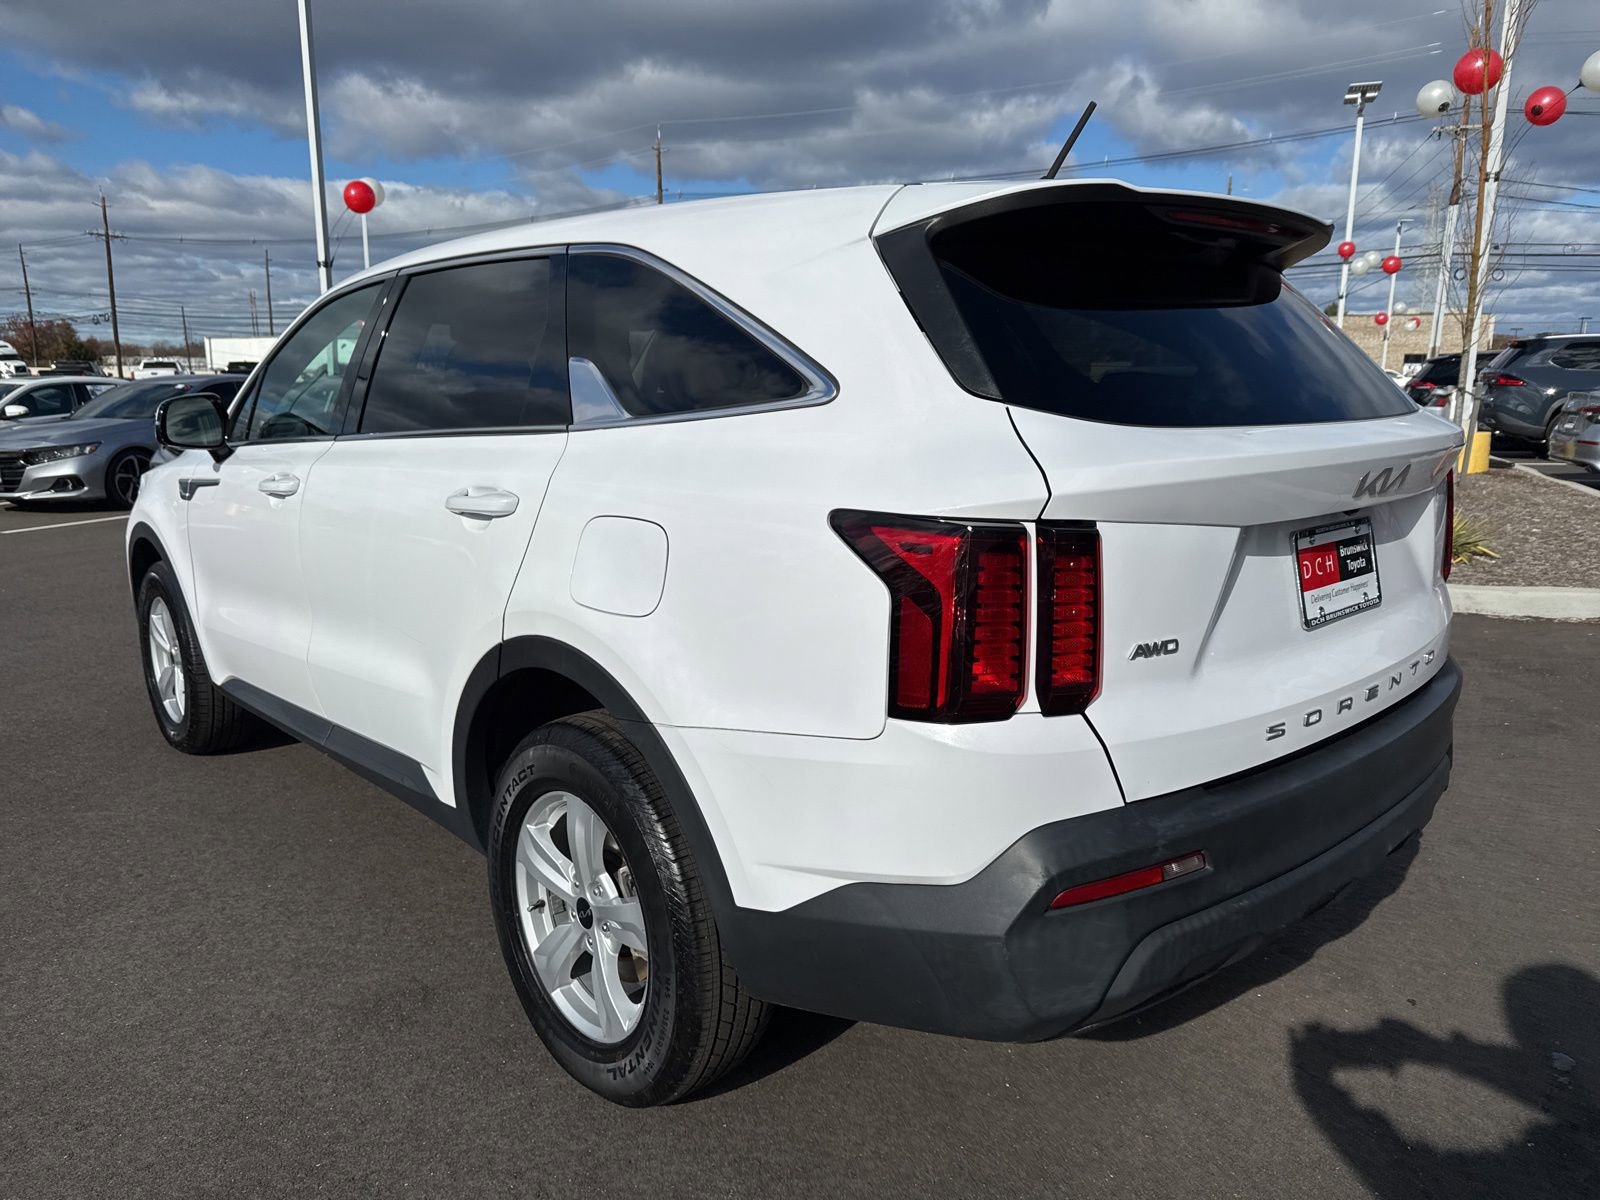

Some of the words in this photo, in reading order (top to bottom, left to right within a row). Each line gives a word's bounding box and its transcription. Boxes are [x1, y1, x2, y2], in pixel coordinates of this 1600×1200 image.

[1340, 539, 1369, 557] Brunswick
[1346, 557, 1366, 573] Toyota
[1311, 616, 1325, 626] DCH
[1325, 605, 1359, 620] BRUNSWICK
[1359, 598, 1380, 609] TOYOTA
[1128, 638, 1179, 661] AWD
[1265, 650, 1436, 742] SORENTO
